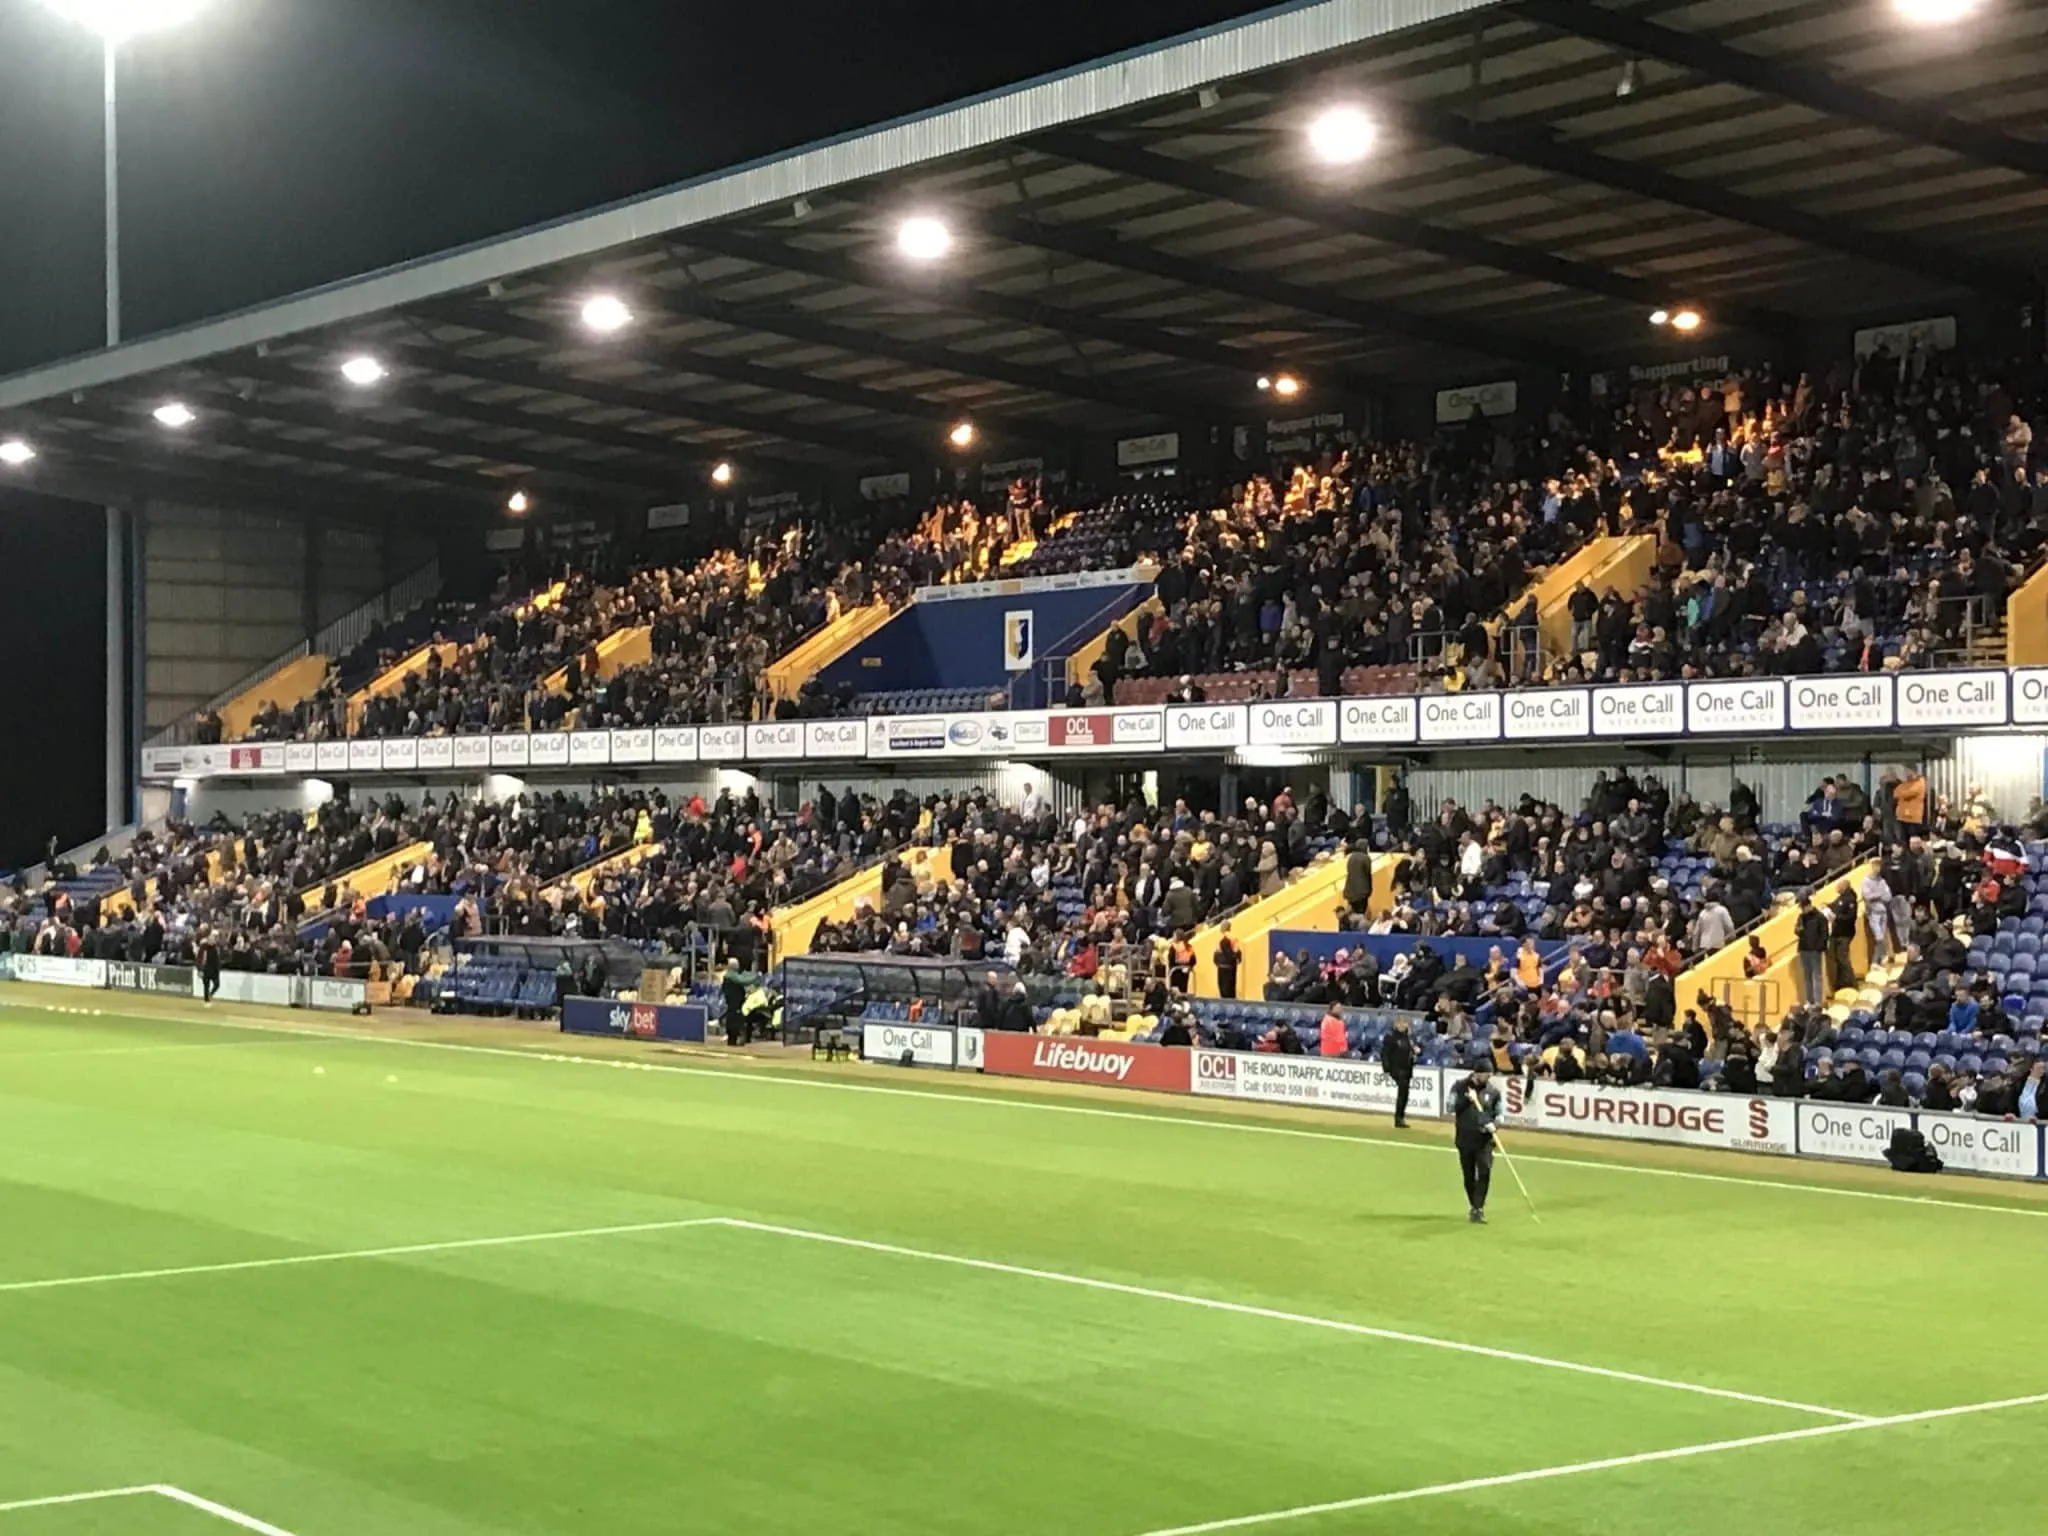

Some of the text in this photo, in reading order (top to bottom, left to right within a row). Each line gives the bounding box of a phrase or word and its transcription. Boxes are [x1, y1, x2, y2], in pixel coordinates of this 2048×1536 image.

[1696, 688, 1774, 711] One Call
[1798, 684, 1881, 708] One Call
[1906, 680, 1995, 704] One Call
[1347, 704, 1408, 724] One Call
[1426, 700, 1492, 722] One Call
[1511, 697, 1580, 718] One Call
[1600, 693, 1673, 715] One Call
[1065, 718, 1092, 735] OCL
[1118, 717, 1155, 731] One Call
[1178, 711, 1235, 731] One Call
[1262, 707, 1323, 728] One Call
[703, 730, 740, 746] One Call
[755, 727, 796, 744] One Call
[814, 725, 857, 743] One Call
[108, 963, 137, 988] Print
[140, 966, 157, 990] UK
[609, 1005, 656, 1032] sky bet
[883, 1028, 933, 1050] One Call
[1033, 1040, 1136, 1081] Lifebuoy
[1199, 1055, 1236, 1080] OCL
[1241, 1060, 1260, 1076] THE
[1260, 1061, 1286, 1078] ROAD
[1287, 1064, 1324, 1081] TRAFFIC
[1325, 1067, 1372, 1086] ACCIDENT
[1543, 1092, 1725, 1135] SURRIDGE
[1812, 1112, 1853, 1137] One
[1931, 1122, 2021, 1153] One Call
